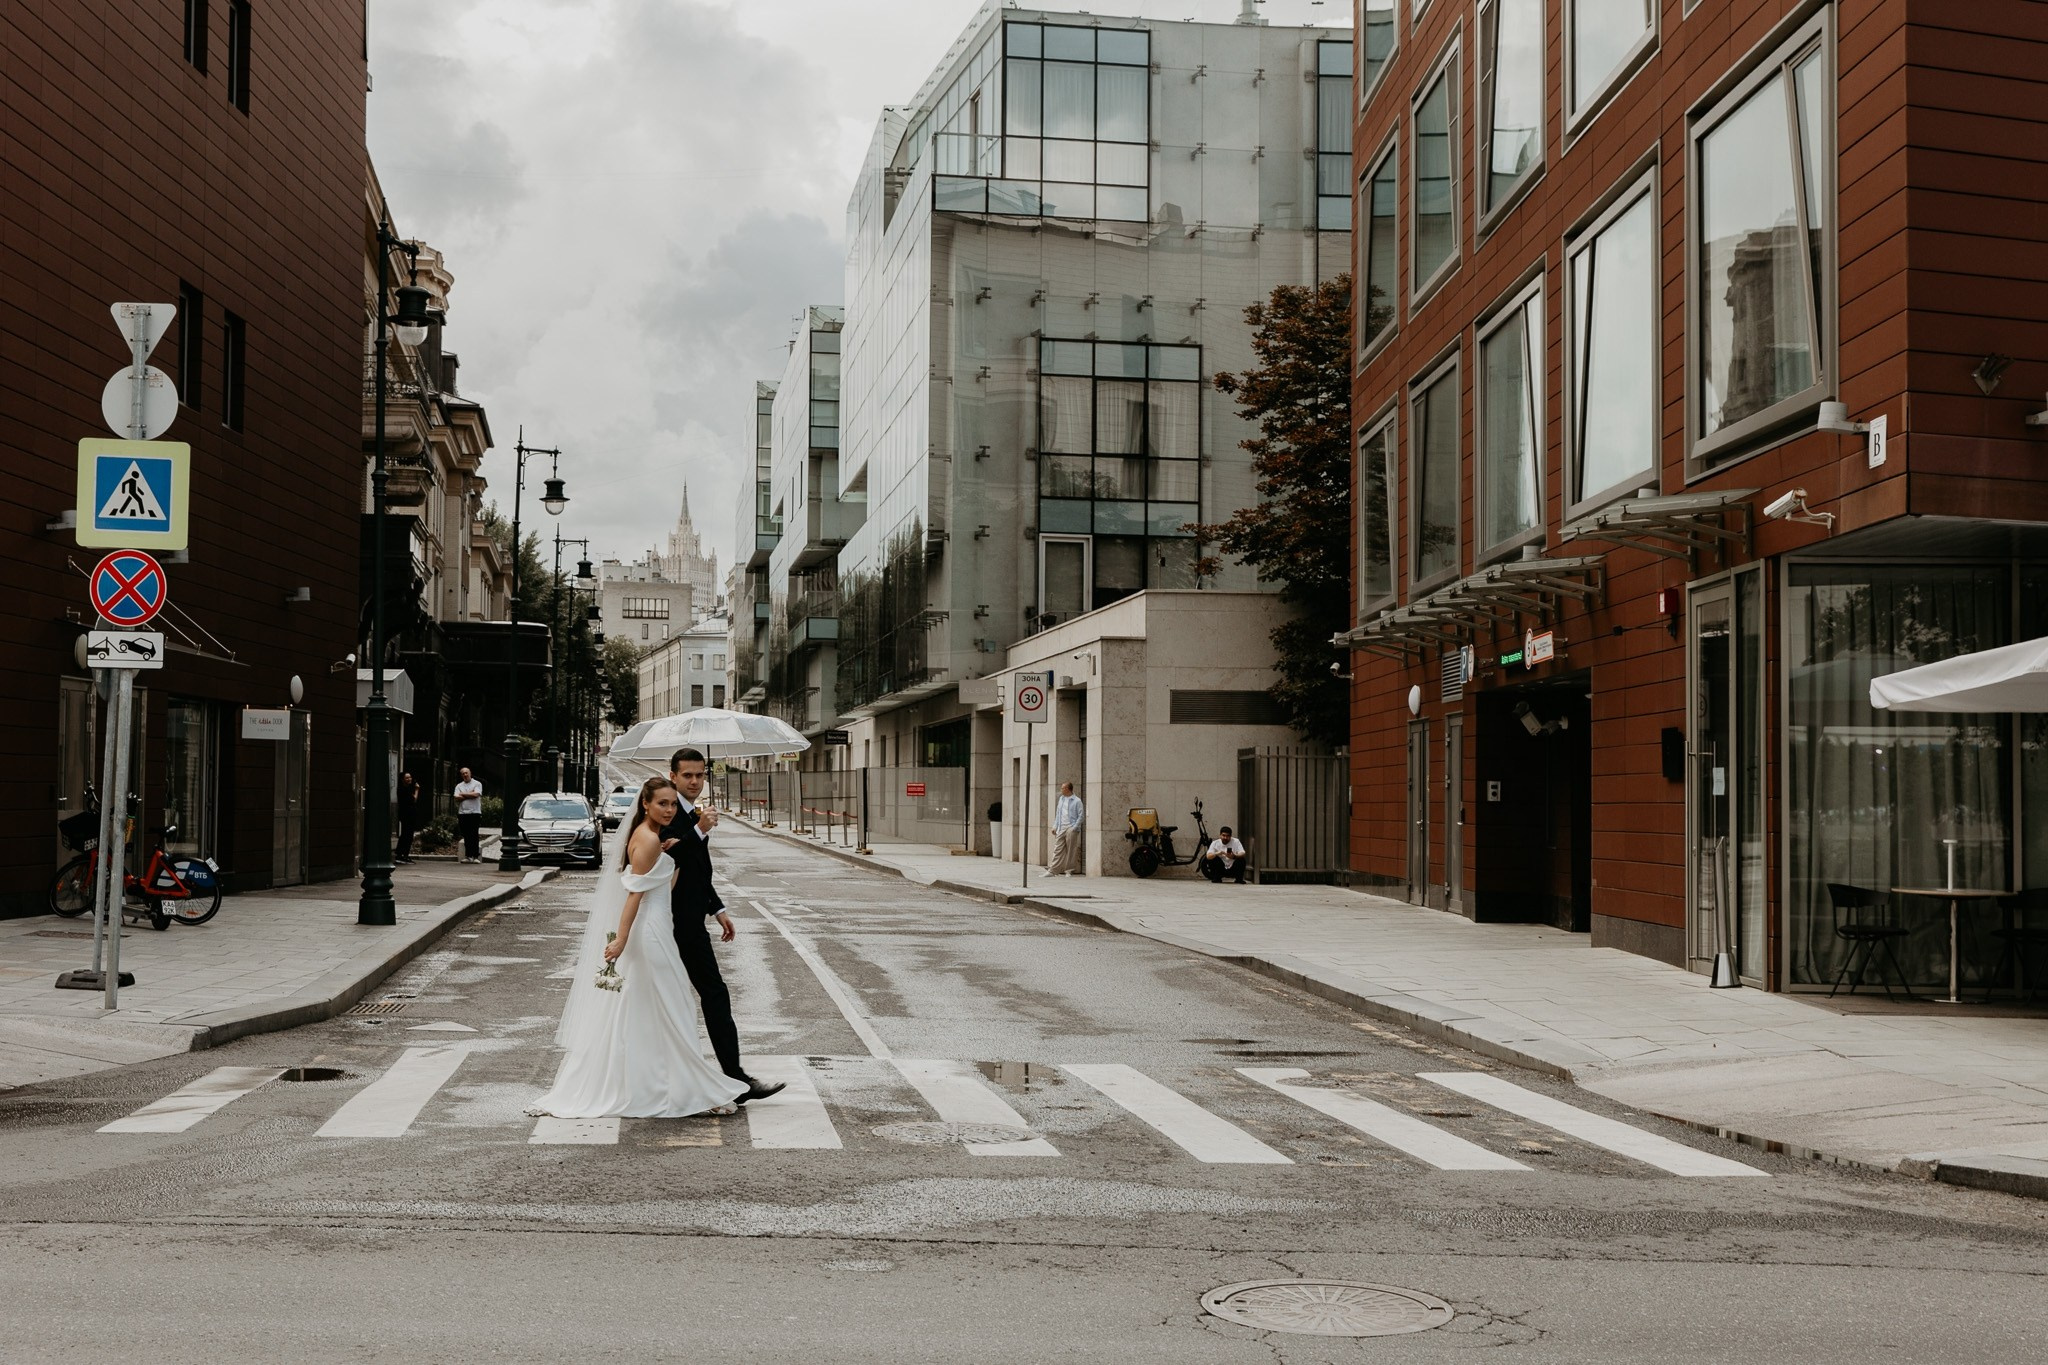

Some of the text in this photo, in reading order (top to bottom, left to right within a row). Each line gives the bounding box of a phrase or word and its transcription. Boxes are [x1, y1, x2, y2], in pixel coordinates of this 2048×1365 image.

[1461, 651, 1467, 679] P
[1024, 693, 1038, 704] 30
[194, 871, 208, 879] ВТБ
